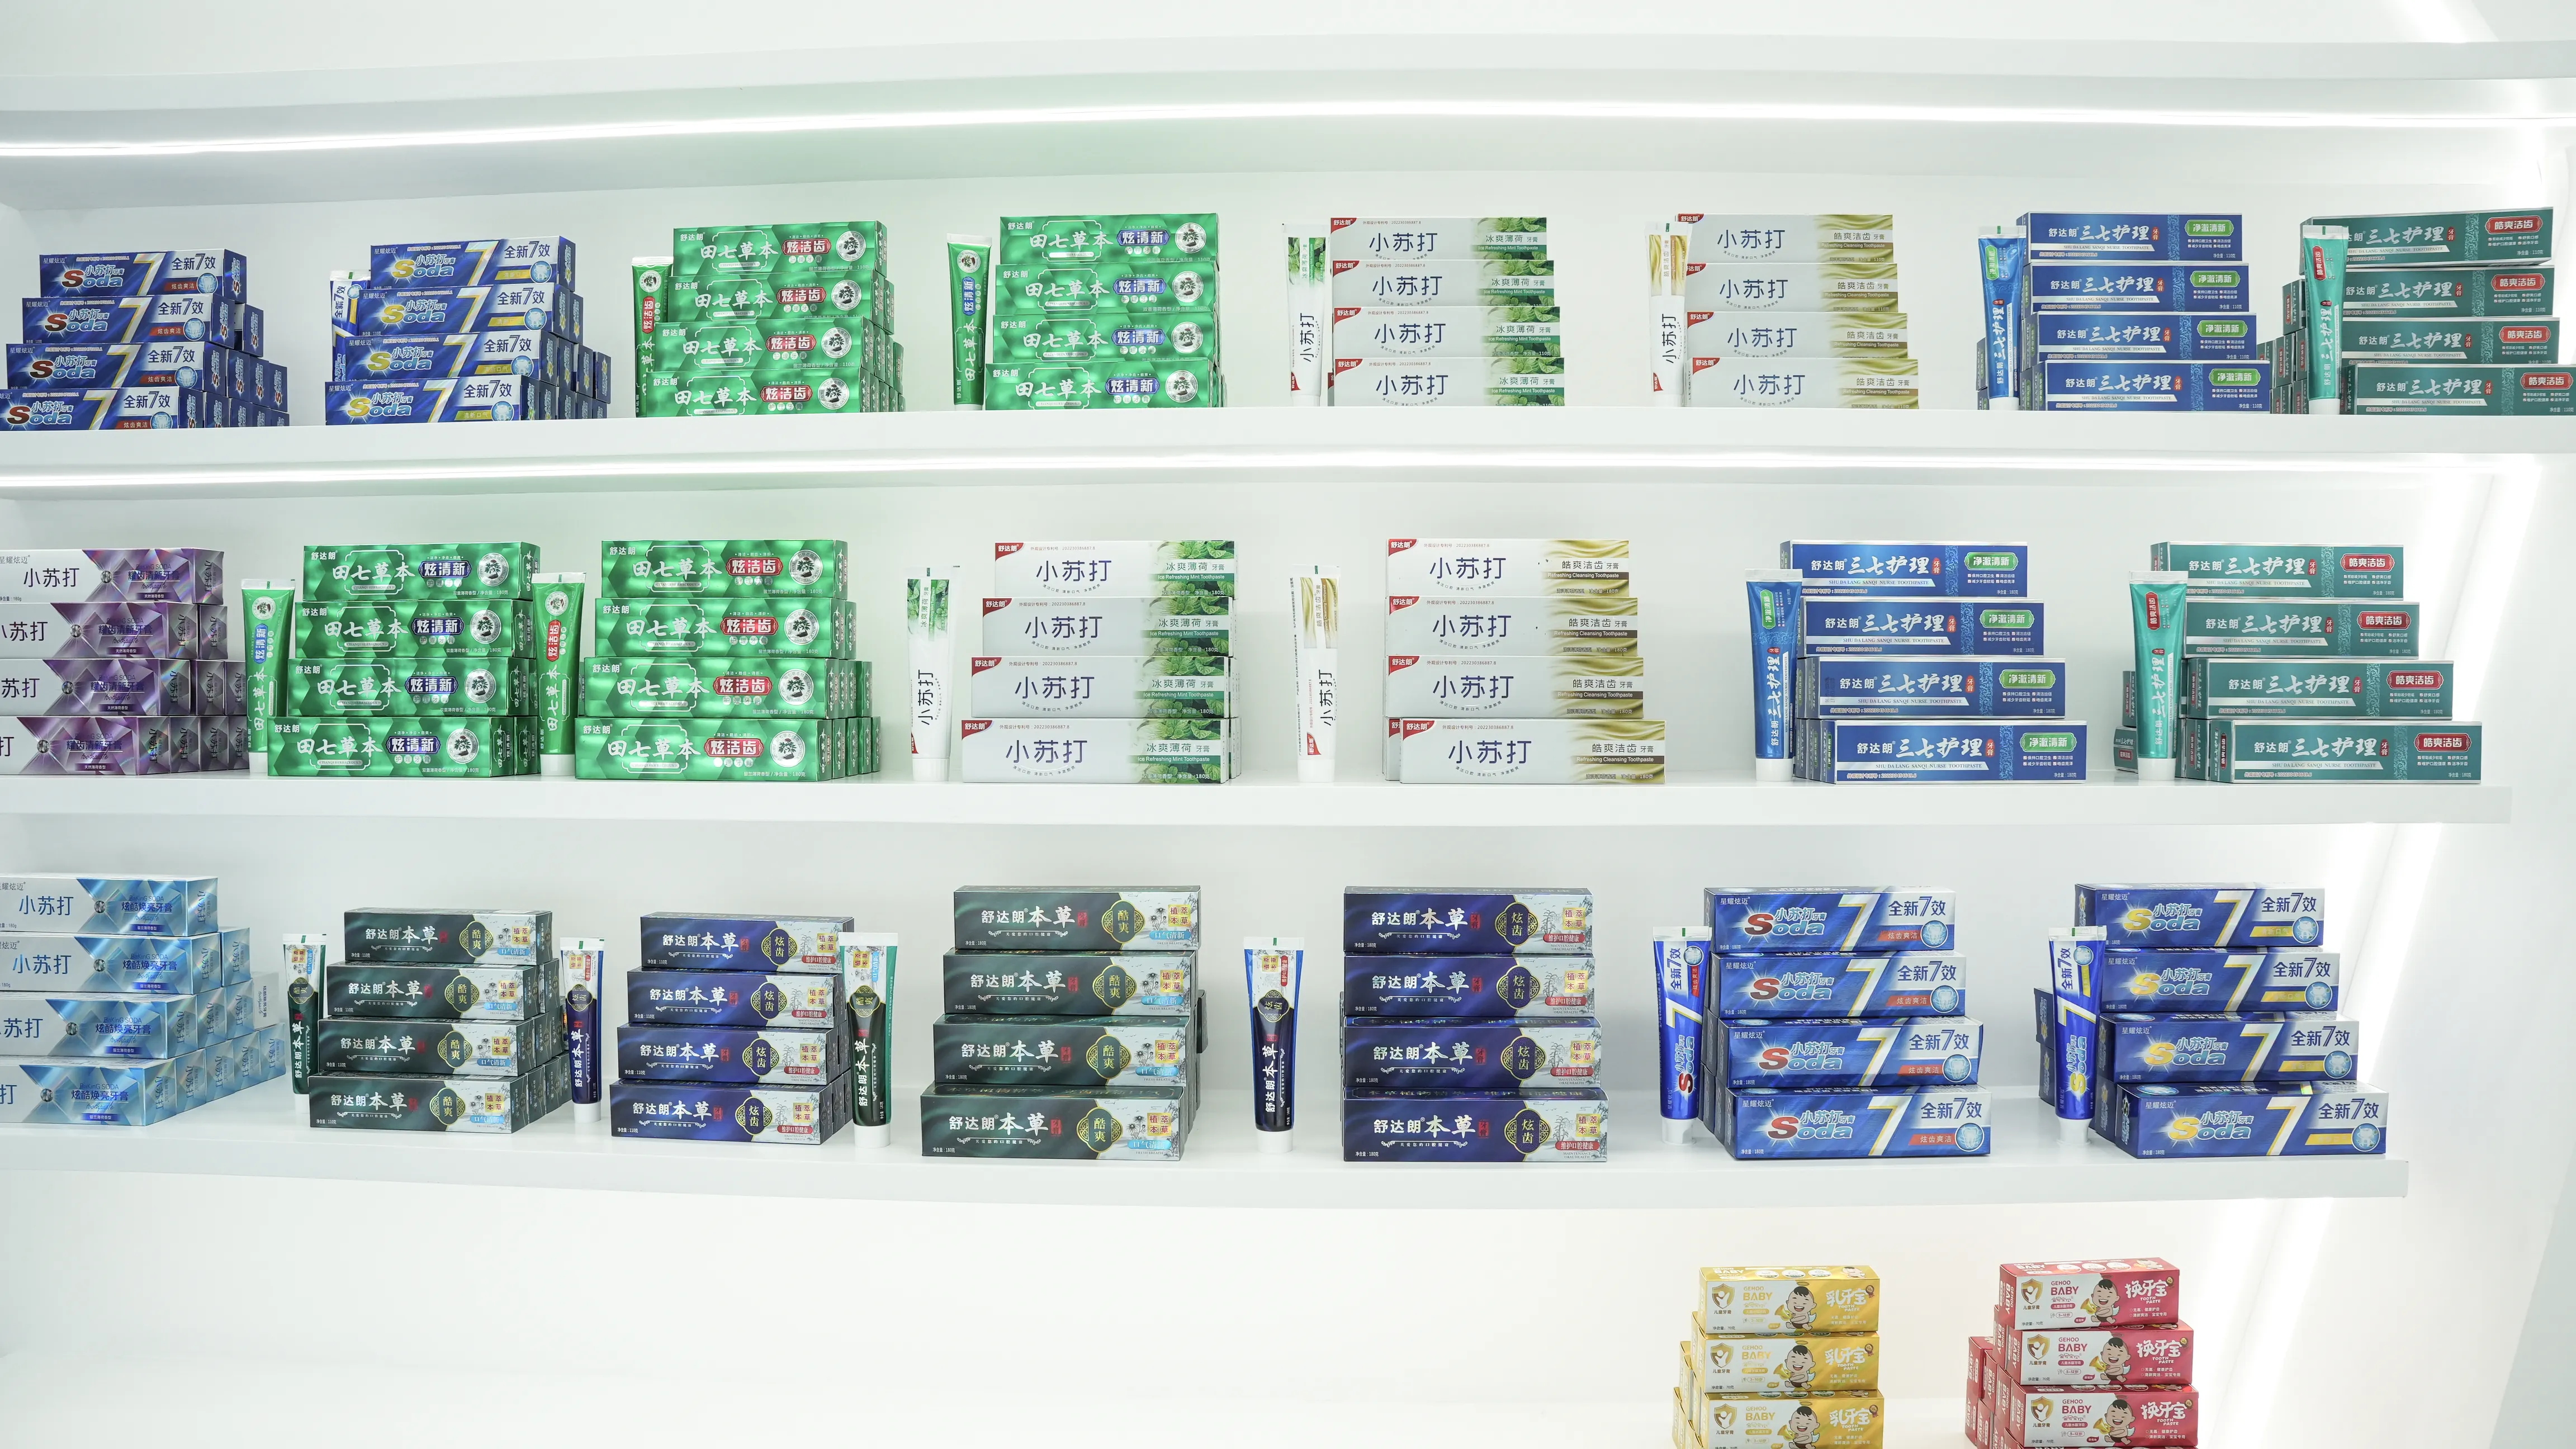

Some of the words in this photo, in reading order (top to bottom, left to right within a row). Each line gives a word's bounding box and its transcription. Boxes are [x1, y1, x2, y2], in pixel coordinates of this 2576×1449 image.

[1030, 230, 1114, 250] 田七草本
[1121, 231, 1163, 245] 炫清新
[1369, 233, 1437, 252] 小苏打
[1717, 229, 1785, 249] 小苏打
[2048, 228, 2077, 238] 舒达朗
[2080, 225, 2149, 242] 三七护理
[2366, 226, 2444, 244] 三七护理
[504, 241, 550, 259] 全新7效
[700, 242, 778, 260] 田七草本
[787, 241, 825, 253] 炫洁齿
[172, 253, 215, 271] 全新7效
[1372, 276, 1442, 296] 小苏打
[1720, 280, 1788, 299] 小苏打
[158, 298, 203, 316] 全新7效
[2089, 326, 2161, 343] 三七护理
[464, 380, 512, 398] 全新7效
[1016, 380, 1102, 397] 田七草本
[1376, 375, 1448, 395] 小苏打
[1734, 375, 1805, 395] 小苏打
[2098, 375, 2171, 392] 三七护理
[2408, 379, 2482, 396] 三七护理
[124, 391, 170, 409] 全新7效
[674, 387, 757, 406] 田七草本
[765, 387, 807, 400] 炫洁齿
[333, 562, 415, 582] 田七草本
[424, 562, 465, 577] 炫清新
[632, 560, 723, 579] 田七草本
[731, 560, 779, 572] 炫洁齿
[1036, 560, 1112, 582] 小苏打
[1429, 557, 1507, 579] 小苏打
[1811, 560, 1844, 571] 舒达朗
[1847, 556, 1930, 576] 三七护理
[2189, 561, 2222, 571] 舒达朗
[2224, 557, 2305, 576] 三七护理
[23, 567, 79, 587] 小苏打
[986, 600, 1006, 608] 舒达朗
[1025, 616, 1102, 638] 小苏打
[1433, 675, 1514, 699] 小苏打
[918, 669, 934, 725] 小苏打
[1319, 669, 1333, 726] 小苏打
[297, 737, 383, 756] 田七草本
[391, 739, 435, 752] 炫清新
[608, 738, 700, 760] 田七草本
[711, 740, 759, 755] 炫洁齿
[1006, 740, 1088, 763] 小苏打
[1448, 740, 1532, 764] 小苏打
[1857, 743, 1892, 754] 舒达朗
[1896, 738, 1983, 759] 三七护理
[2291, 738, 2377, 758] 三七护理
[19, 896, 74, 915] 小苏打
[1720, 897, 1748, 906] 星耀炫迈
[1888, 897, 1946, 917] 全新7效
[2261, 893, 2317, 913] 全新7效
[1888, 931, 1917, 940] 炫齿爽洁
[12, 954, 72, 974] 小苏打
[2274, 958, 2330, 977] 全新7效
[1921, 1098, 1982, 1120] 全新7效
[2318, 1098, 2379, 1119] 全新7效
[1743, 1292, 1772, 1301] BABY
[1826, 1288, 1866, 1306] 乳牙宝
[2051, 1286, 2078, 1295] BABY
[2125, 1280, 2167, 1298] 换牙宝
[1825, 1347, 1865, 1365] 乳牙宝
[2141, 1401, 2186, 1419] 换牙宝
